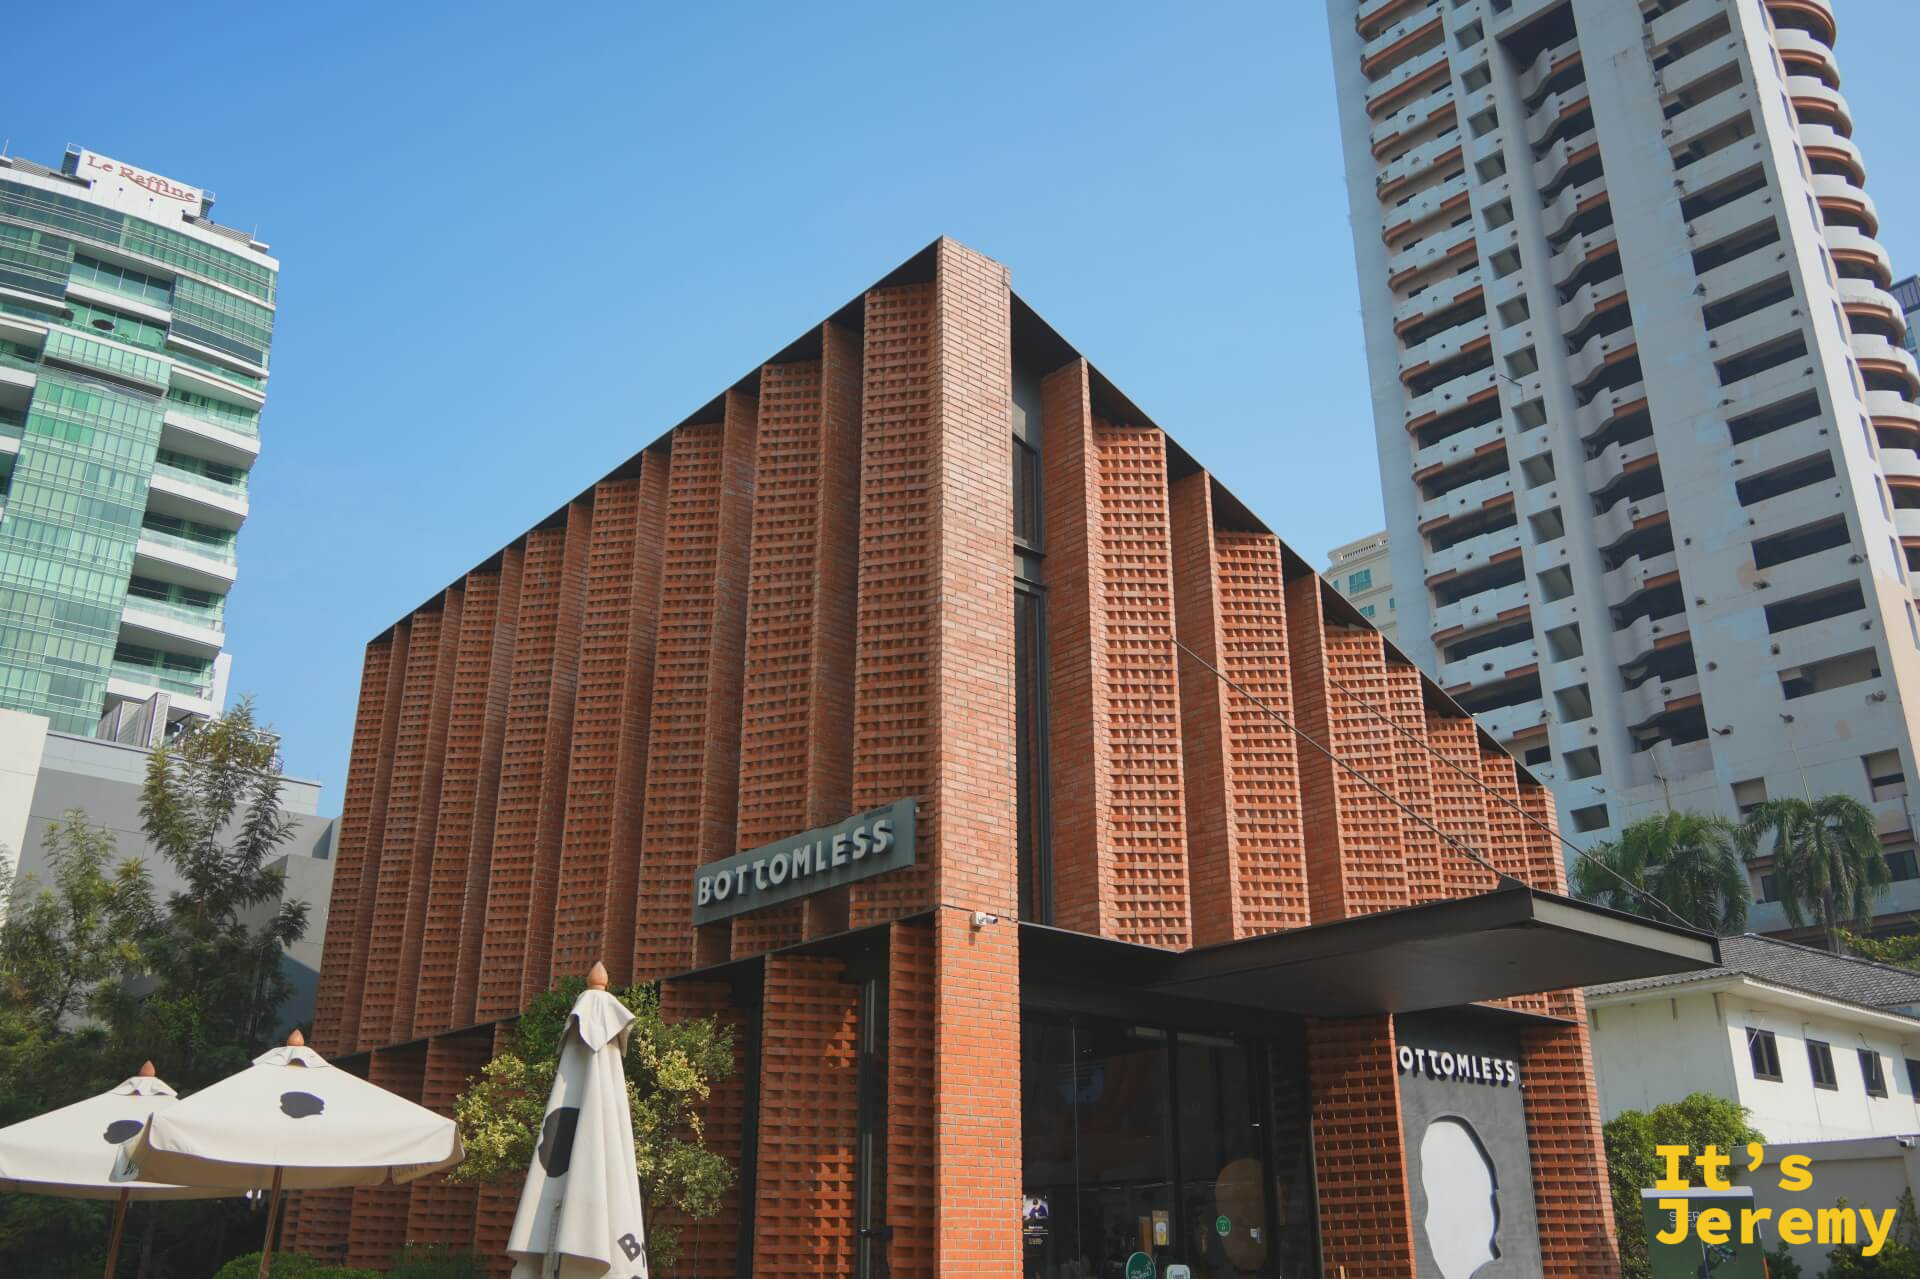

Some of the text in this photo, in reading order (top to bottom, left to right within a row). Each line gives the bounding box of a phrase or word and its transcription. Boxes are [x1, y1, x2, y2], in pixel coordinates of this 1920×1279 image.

[87, 155, 114, 172] Le
[697, 819, 893, 906] BOTTOMLESS
[1399, 1045, 1516, 1083] OTTOMLESS
